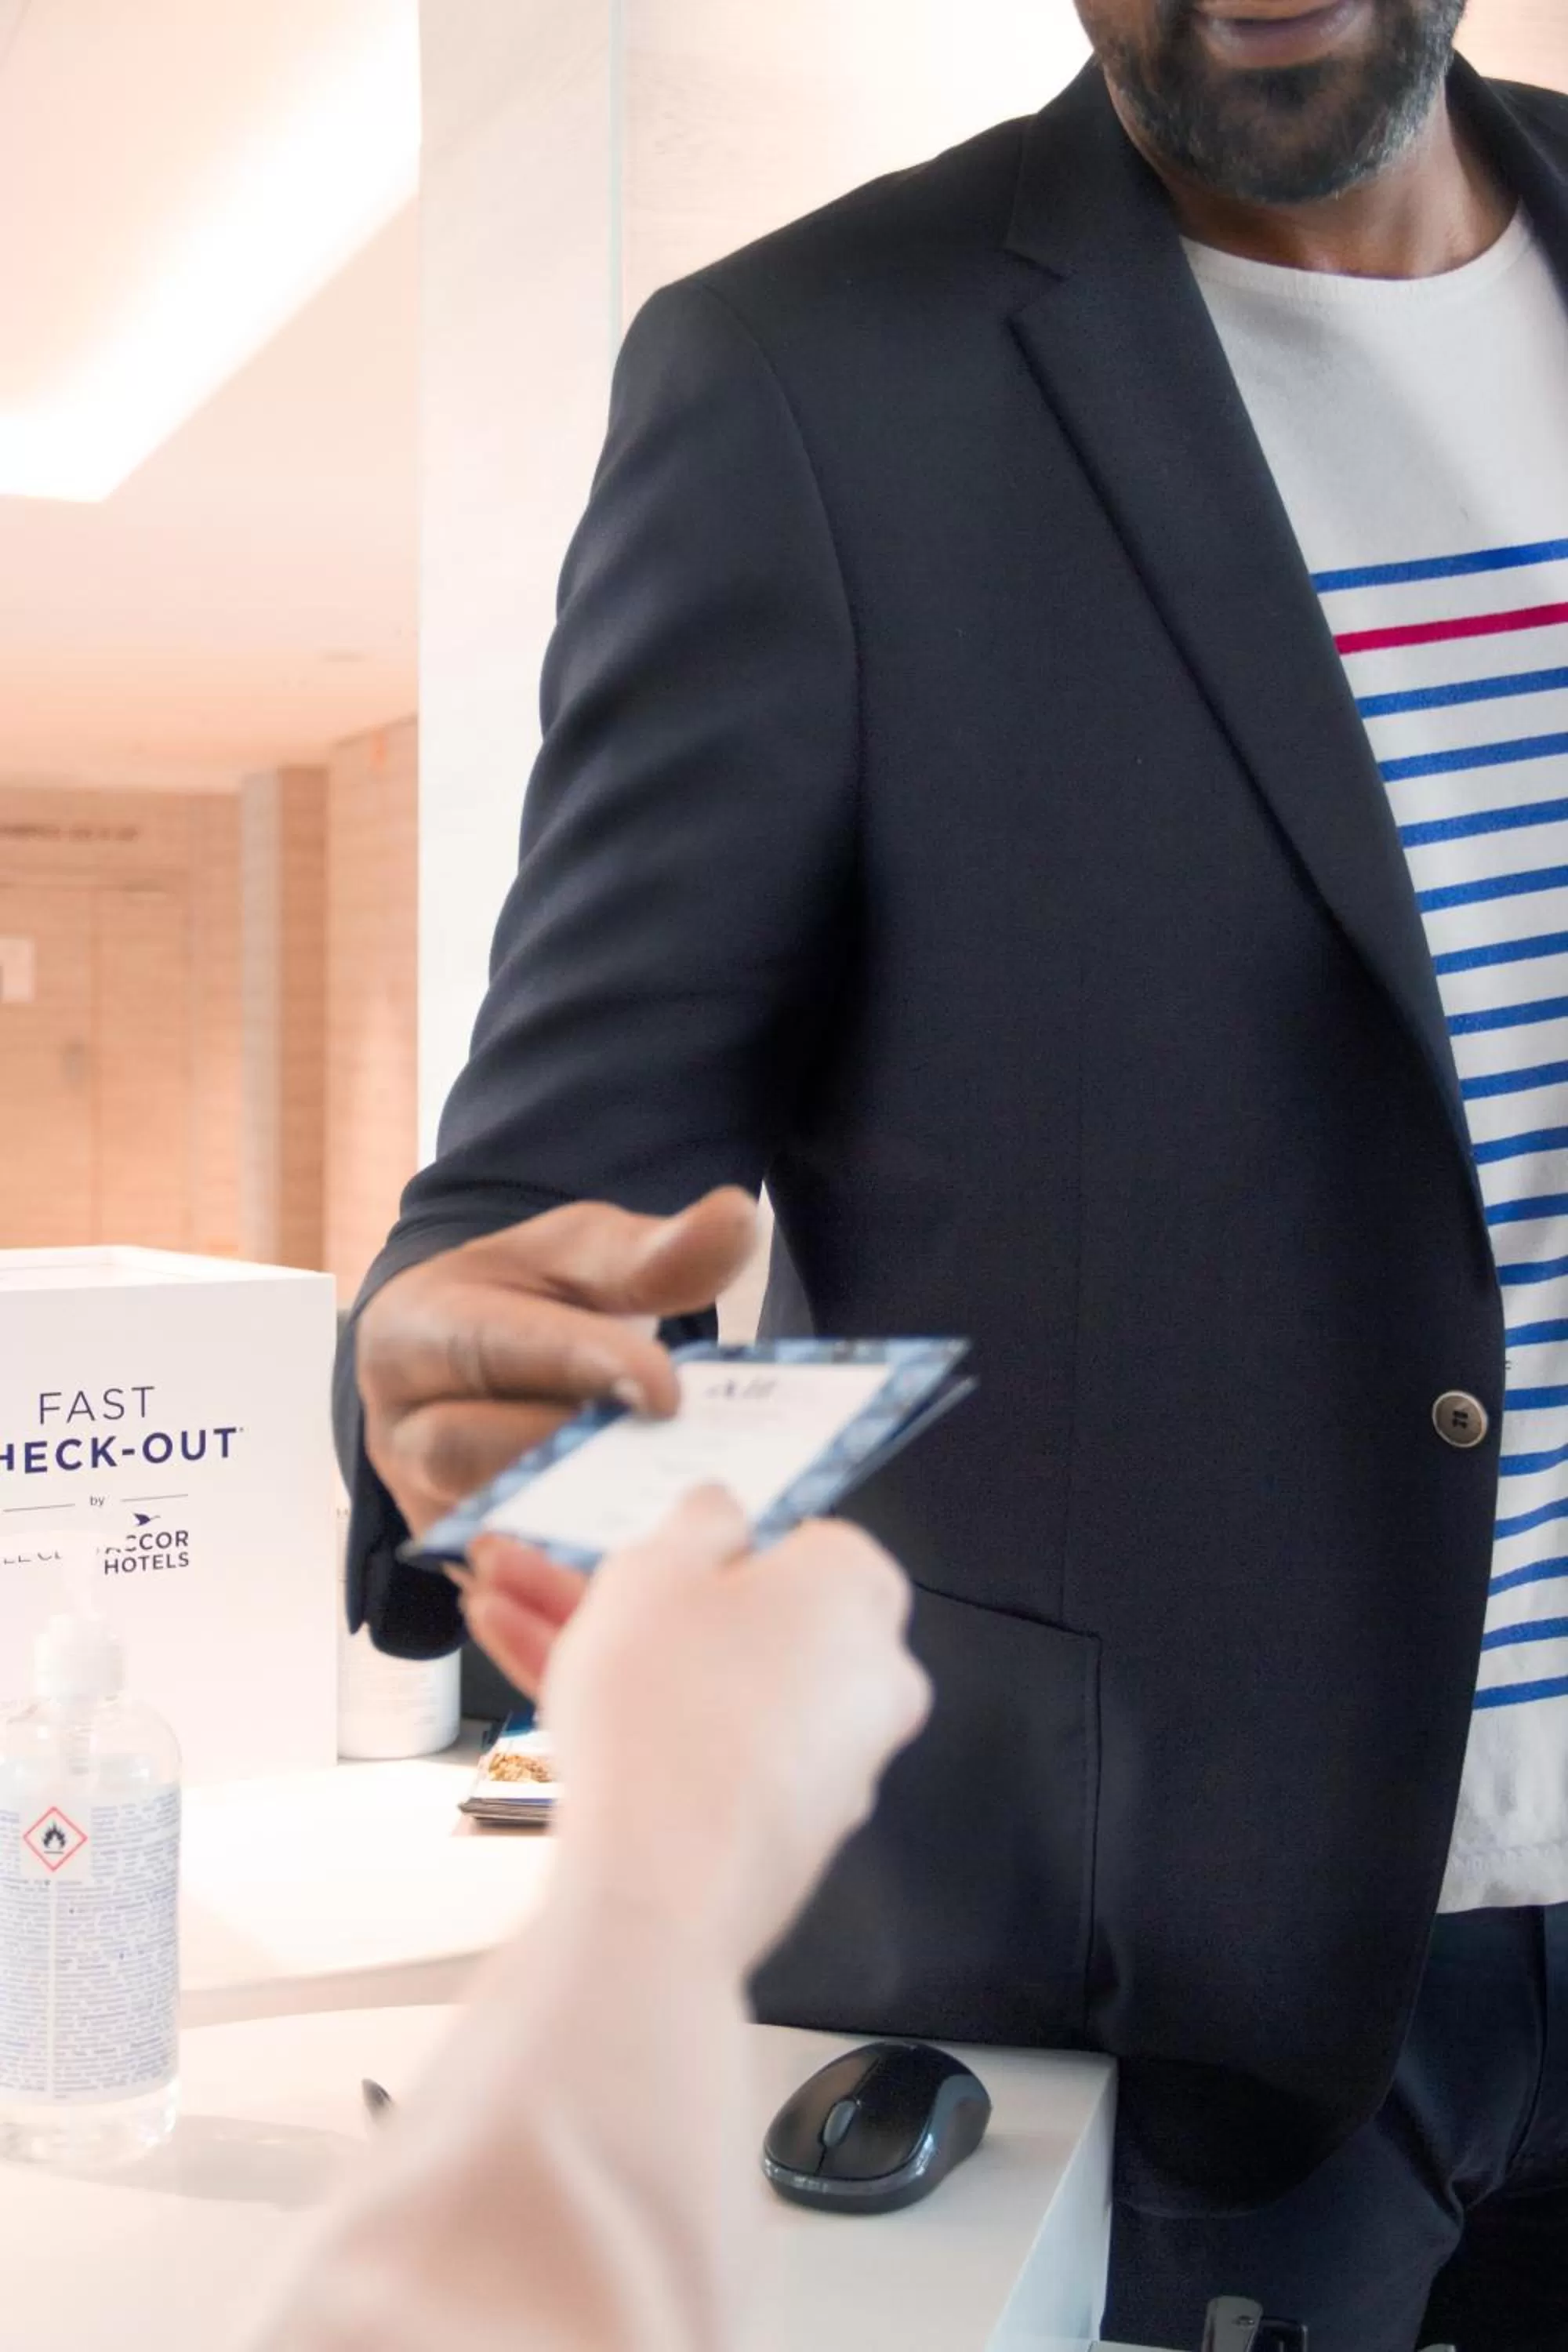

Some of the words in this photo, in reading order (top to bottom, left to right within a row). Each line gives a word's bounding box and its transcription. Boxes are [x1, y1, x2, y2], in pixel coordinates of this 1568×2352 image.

[39, 1385, 155, 1425] FAST
[89, 1495, 105, 1507] by
[104, 1552, 190, 1575] HOTELS
